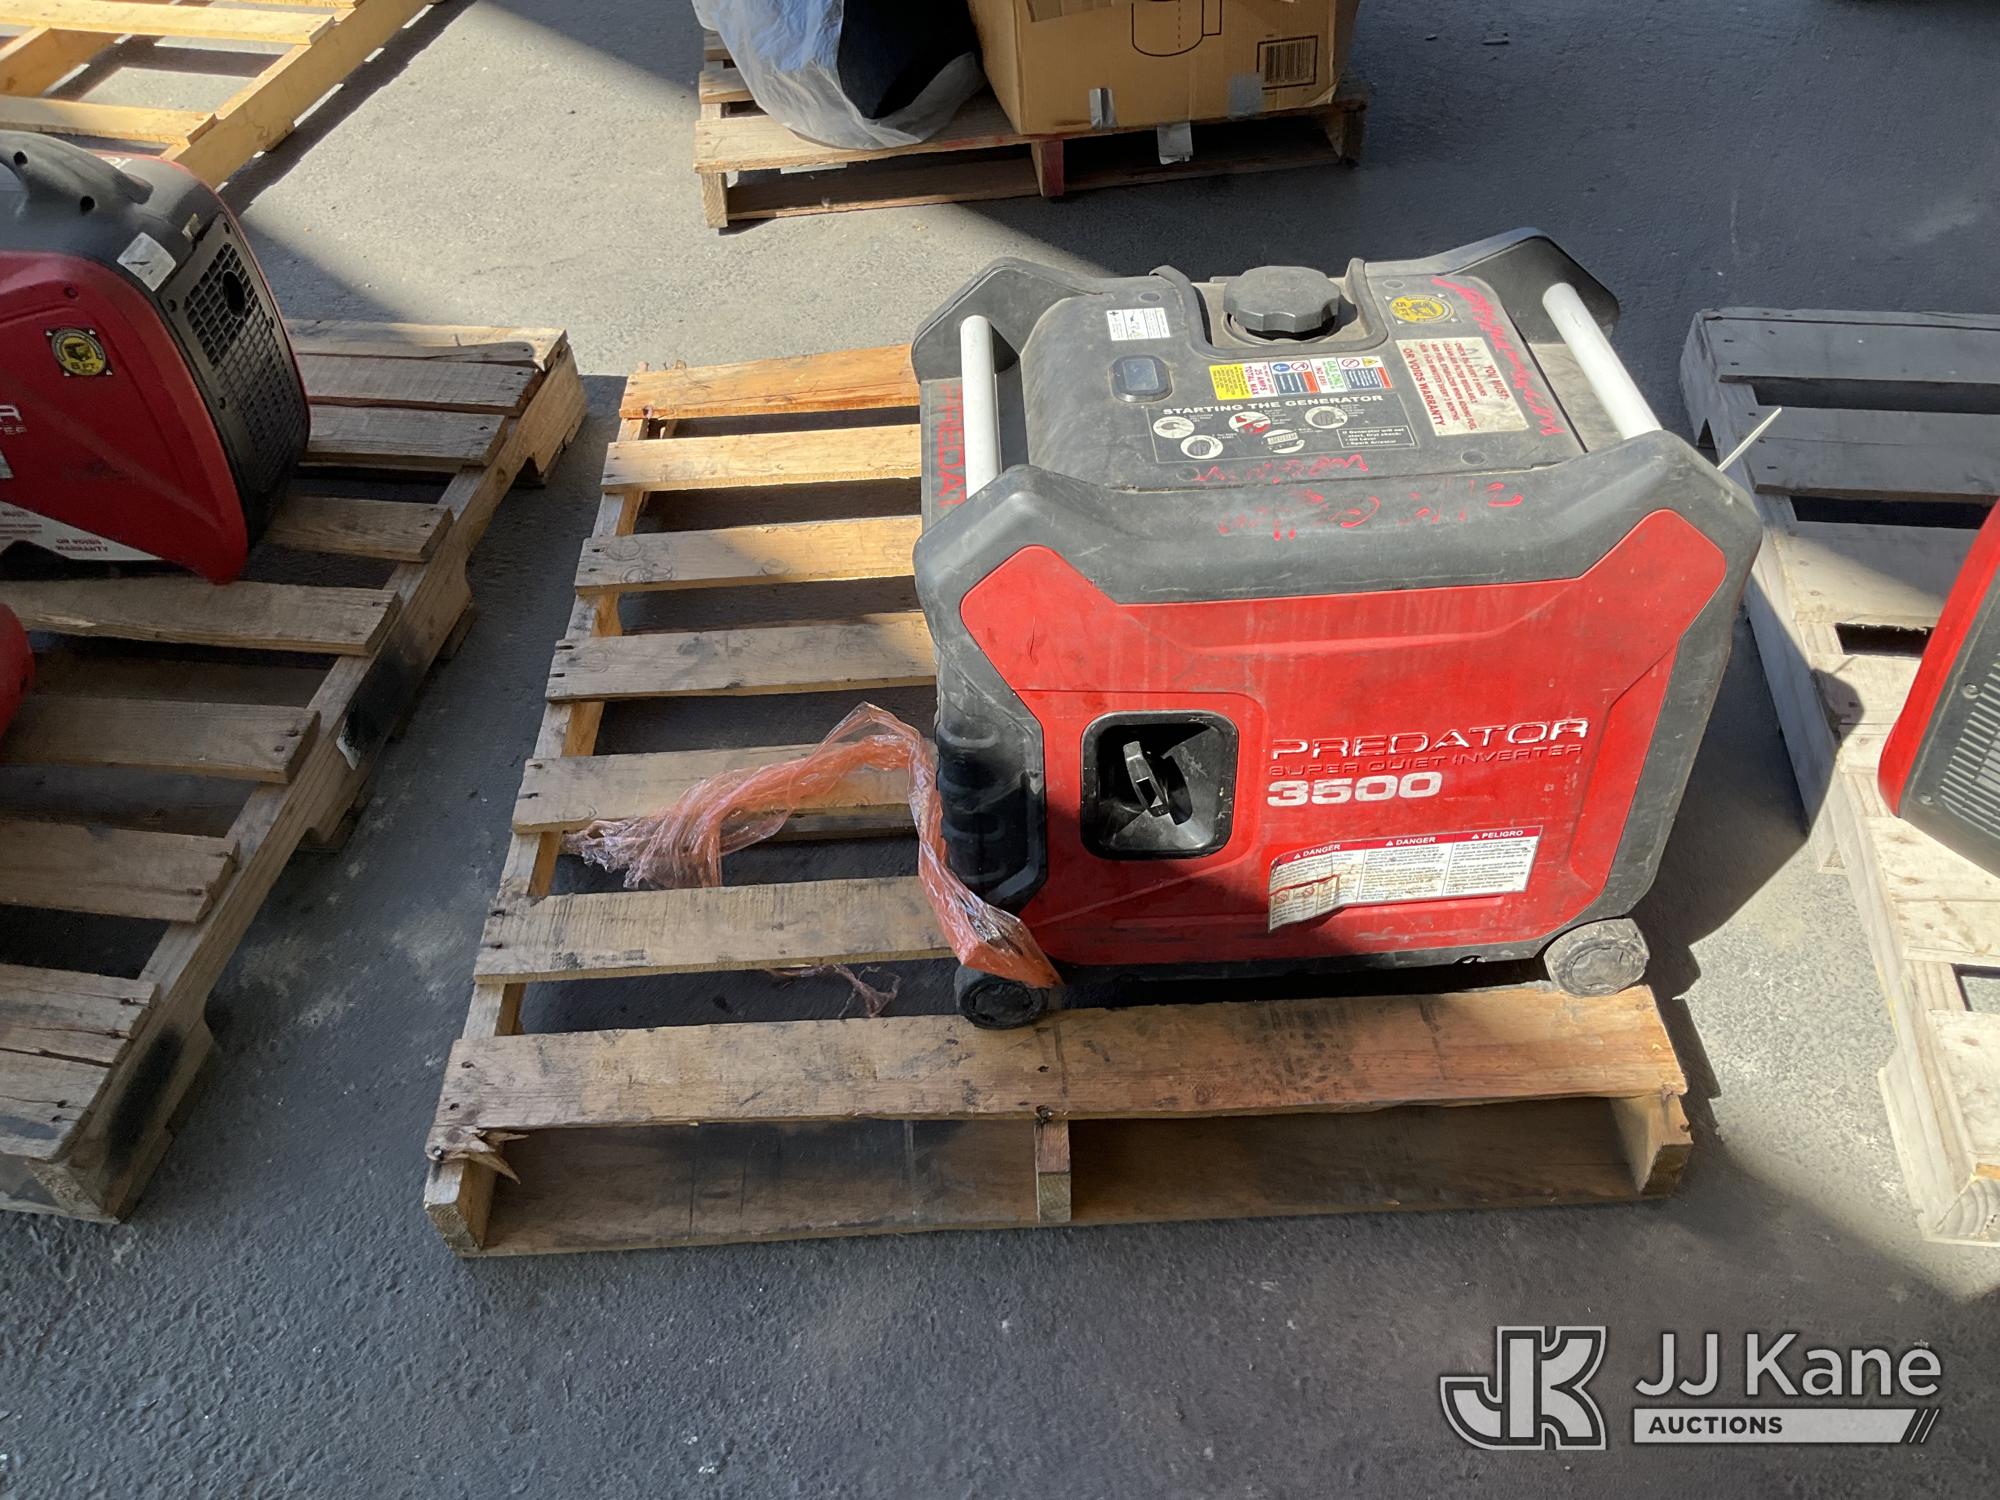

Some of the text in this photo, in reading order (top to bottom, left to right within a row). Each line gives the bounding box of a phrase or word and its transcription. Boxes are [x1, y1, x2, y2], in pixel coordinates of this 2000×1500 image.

[1482, 365, 1499, 378] YOU
[1402, 348, 1445, 425] OR VOIDS WARRANTY
[1162, 404, 1243, 414] STARTING
[1284, 395, 1383, 405] GENERATOR
[1272, 718, 1589, 759] PREDATOR
[1452, 744, 1583, 766] INVERTER
[1268, 772, 1442, 807] 3500
[1396, 837, 1436, 846] DANGER
[1482, 829, 1523, 838] PELIGRO
[1302, 844, 1341, 857] DANGER
